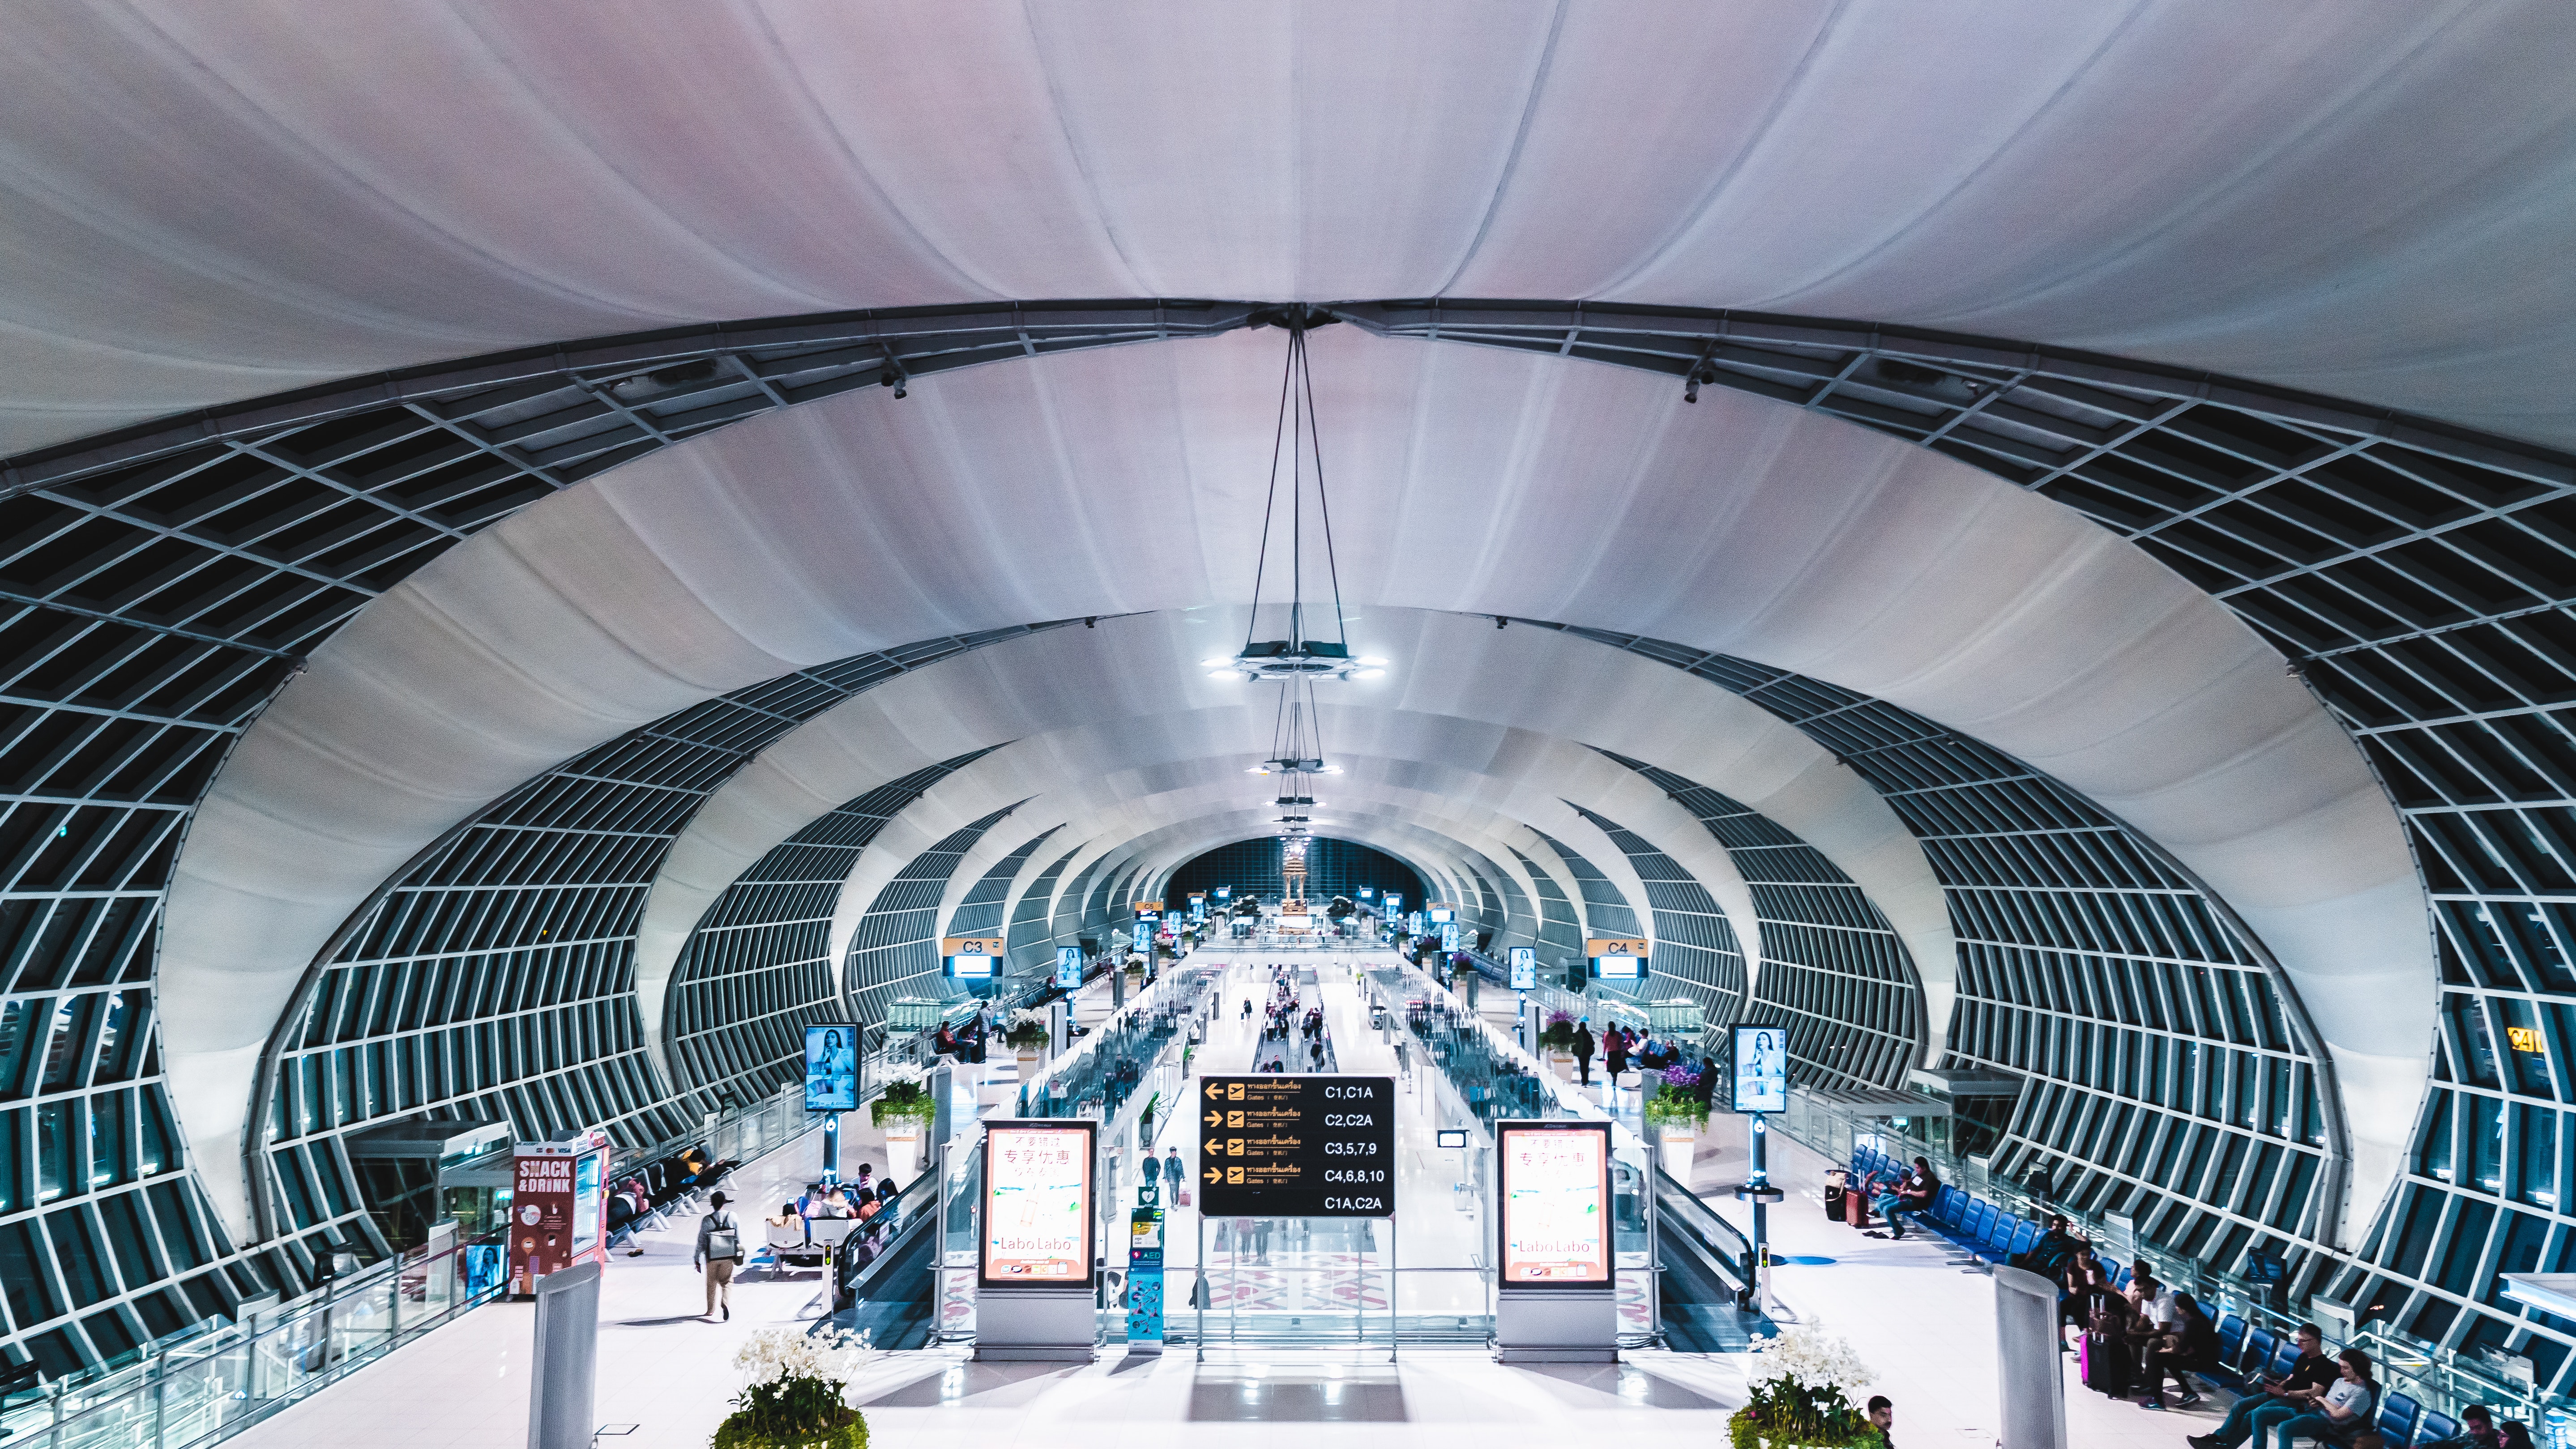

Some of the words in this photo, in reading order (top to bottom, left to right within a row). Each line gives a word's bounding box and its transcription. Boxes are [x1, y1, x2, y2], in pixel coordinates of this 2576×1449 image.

[963, 941, 982, 953] C3
[1608, 942, 1628, 954] C4
[1325, 1087, 1373, 1100] C1,C1A
[1325, 1114, 1373, 1127] C2,C2A
[1325, 1142, 1377, 1156] C3,5,7,9
[1004, 1149, 1070, 1165] 专享优惠
[519, 1160, 571, 1177] SNACK
[1325, 1170, 1384, 1184] C4,6,8,10
[1325, 1198, 1382, 1210] C1A,C2A
